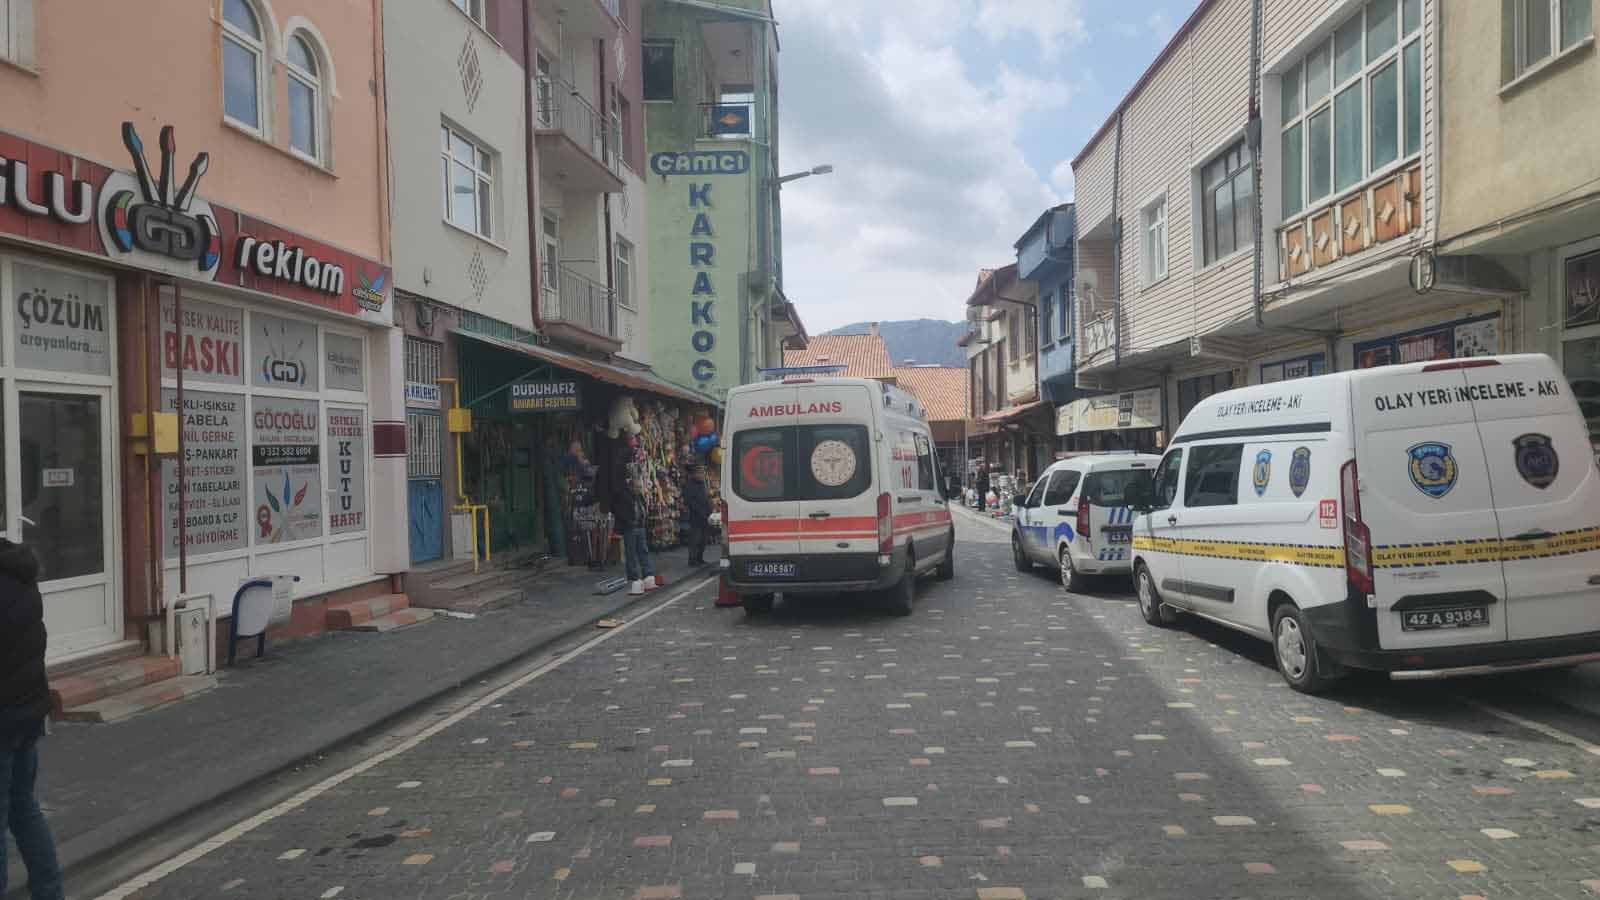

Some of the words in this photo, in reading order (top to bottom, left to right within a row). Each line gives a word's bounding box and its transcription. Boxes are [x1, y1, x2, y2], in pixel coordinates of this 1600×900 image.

[0, 156, 93, 223] LU
[239, 237, 344, 295] reklam
[18, 288, 104, 332] ÇÖZÜM
[165, 330, 239, 377] BASKI
[749, 401, 843, 418] AMBULANS
[1375, 390, 1414, 412] OLAY
[1417, 387, 1453, 406] YERİ
[1455, 380, 1526, 402] İNCELEME
[1537, 379, 1560, 397] AKİ
[191, 480, 240, 492] TABELALARI
[338, 441, 352, 510] KUTU
[330, 512, 362, 527] HARF
[1322, 503, 1335, 517] 112
[1409, 612, 1428, 626] 42
[1431, 611, 1443, 624] A
[1446, 608, 1483, 624] 9384
